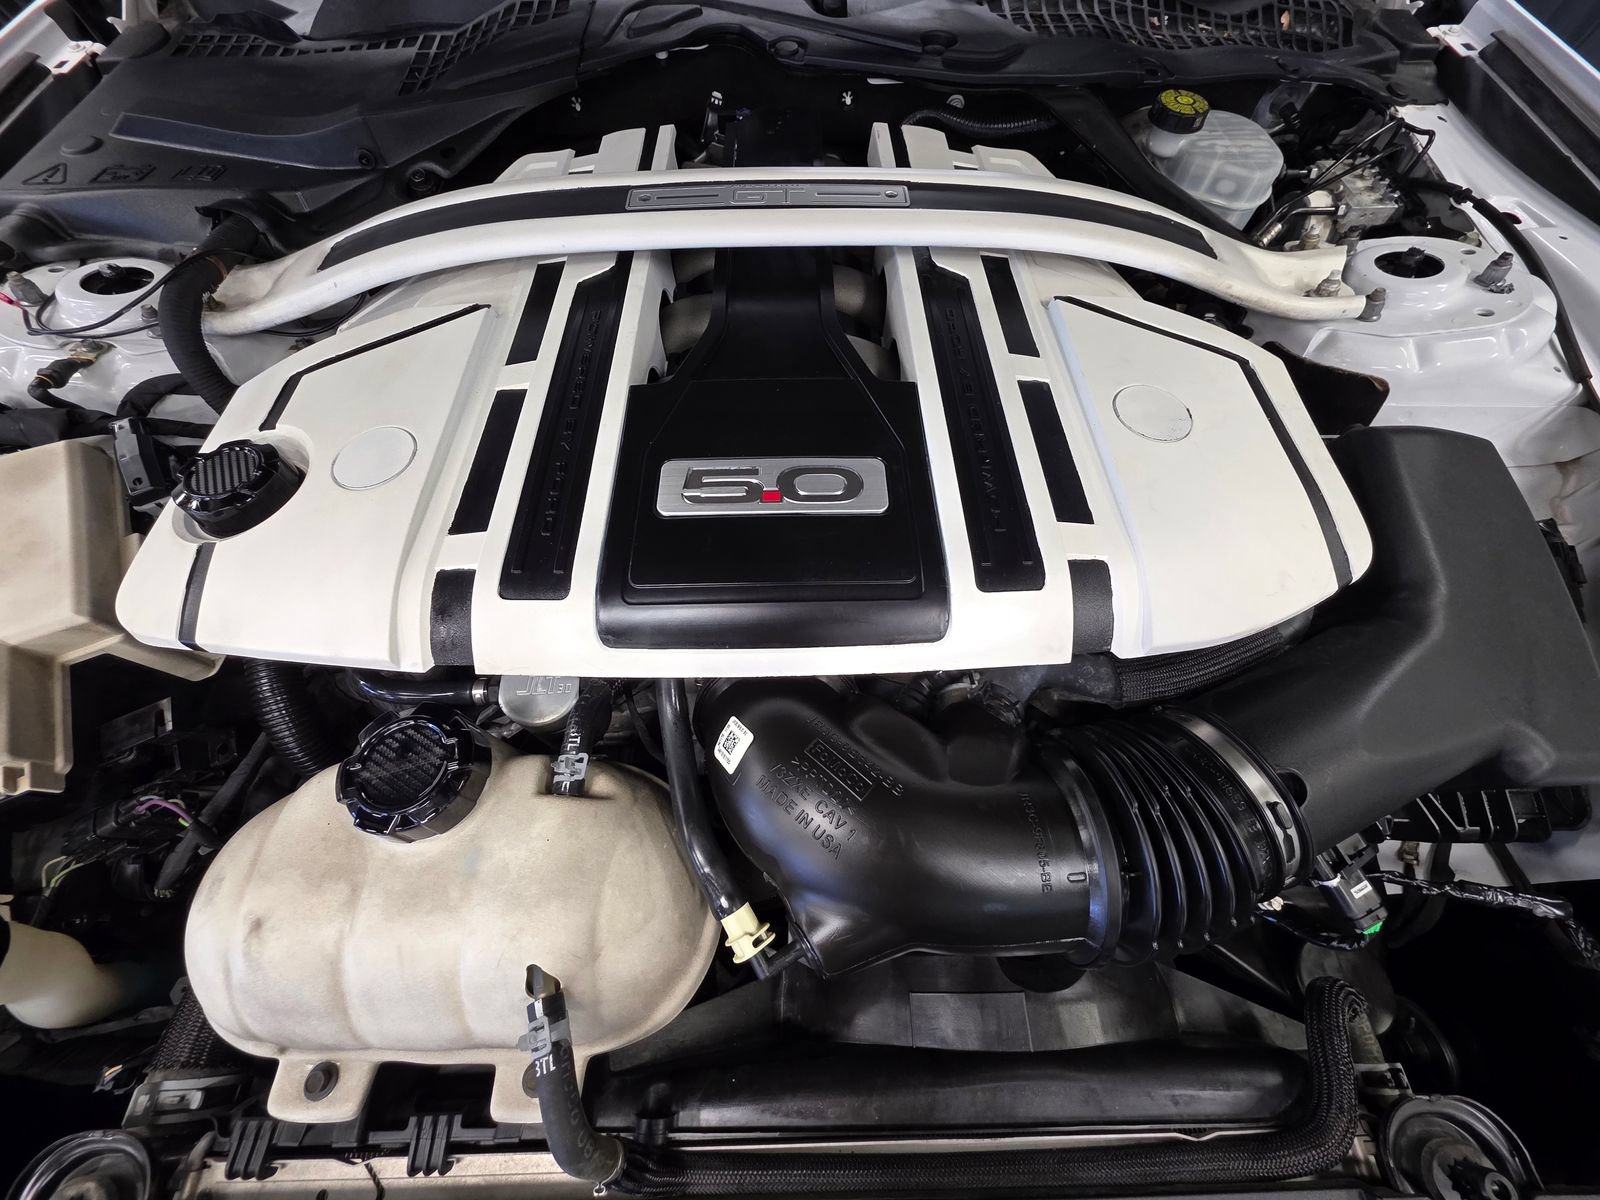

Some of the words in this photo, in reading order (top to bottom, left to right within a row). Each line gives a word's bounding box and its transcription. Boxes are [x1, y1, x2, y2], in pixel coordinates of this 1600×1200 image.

[730, 187, 806, 205] GT
[681, 464, 865, 505] 5.0
[812, 743, 865, 793] FoMoCo
[756, 774, 798, 816] MADE
[794, 809, 814, 830] IN
[812, 824, 843, 861] USA
[814, 799, 847, 831] CAV
